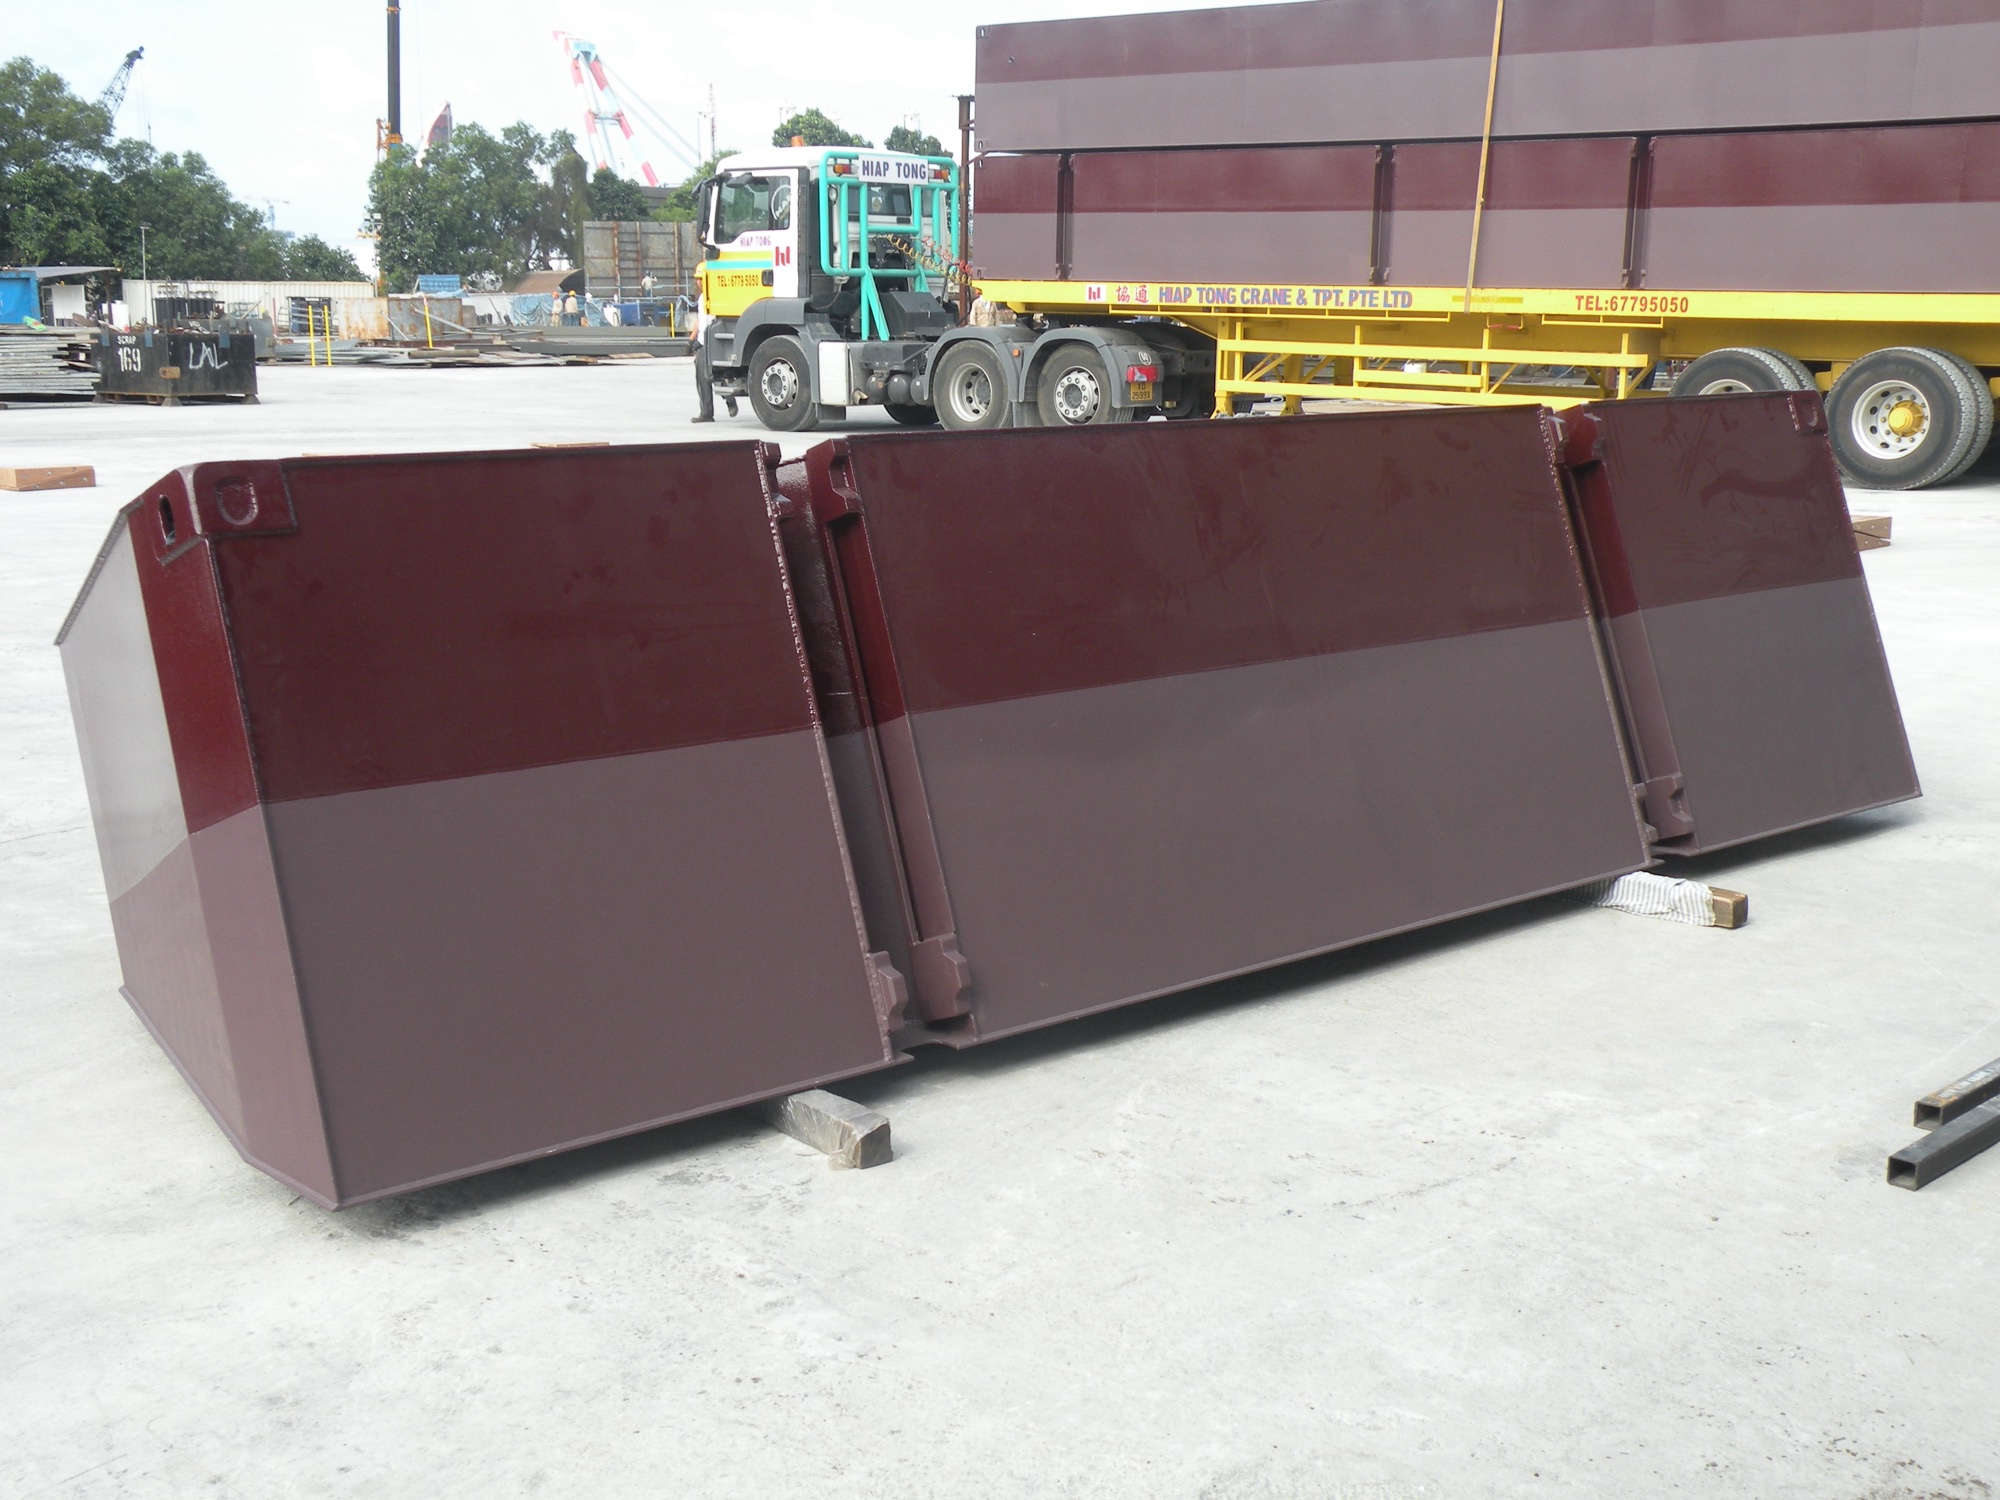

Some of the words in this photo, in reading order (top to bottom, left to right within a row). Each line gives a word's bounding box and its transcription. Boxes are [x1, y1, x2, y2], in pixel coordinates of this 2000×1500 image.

[862, 160, 889, 177] HIAP
[896, 162, 926, 180] TONG
[740, 236, 753, 247] HIAP
[1158, 286, 1192, 304] HIAP
[1196, 286, 1236, 306] TONG
[1240, 287, 1292, 307] CRANE
[1296, 289, 1308, 307] &
[1312, 288, 1345, 308] TPT.
[1348, 288, 1380, 308] PTE
[1382, 289, 1413, 310] LTD
[117, 335, 137, 345] SCRAP
[118, 347, 142, 372] 169
